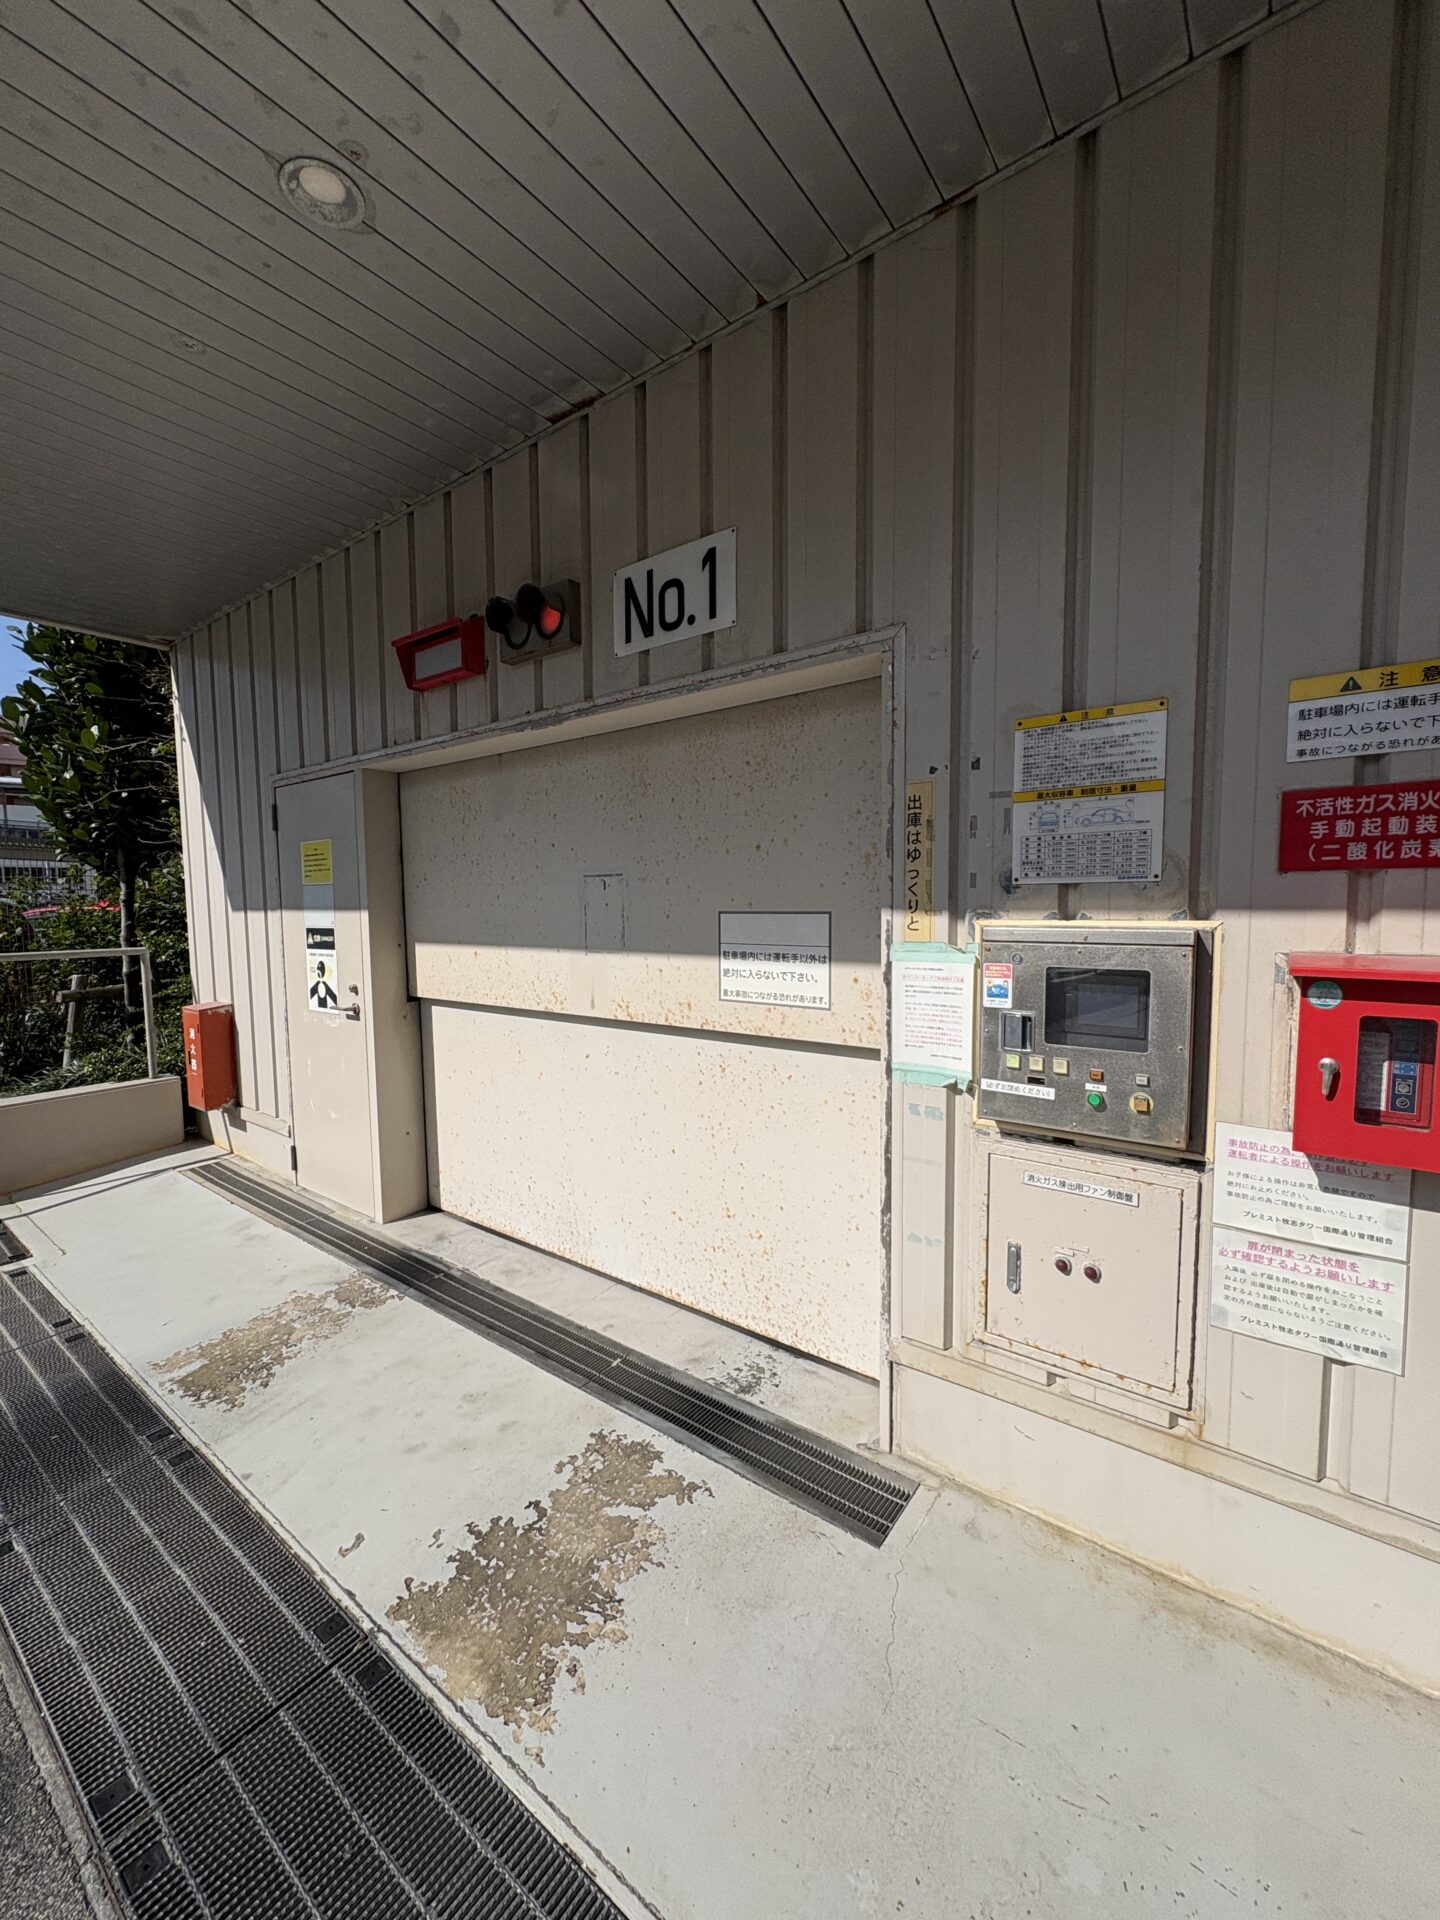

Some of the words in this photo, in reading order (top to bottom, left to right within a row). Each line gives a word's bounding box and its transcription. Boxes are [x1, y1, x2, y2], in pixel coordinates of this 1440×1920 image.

[624, 546, 718, 644] No.1
[1379, 666, 1440, 688] 注意
[1297, 692, 1440, 721] 駐車場内には運転手
[1297, 714, 1440, 742] 絶対に入らないで下
[1296, 789, 1440, 818] 不活性ガス消火
[1309, 813, 1438, 839] 手動起動装
[906, 794, 922, 932] 出庫はゆっくりと
[722, 950, 828, 965] 駐車場内には運転手以外は
[722, 968, 818, 983] 絶対に入らないで下さい。
[722, 988, 828, 1005] 重大事故につながる恐れがあります。
[1227, 1148, 1395, 1182] 運転者による操作をお願いします
[1027, 1173, 1134, 1203] 消火ガス排出用ファン制御盤
[1226, 1180, 1310, 1201] 絶対にお止めください。
[1226, 1190, 1379, 1225] 事故防止の為ご理解をお願いいたします。
[1218, 1247, 1395, 1292] 必ず確認するようお願いします
[1247, 1240, 1360, 1273] 扉が閉まった状態を
